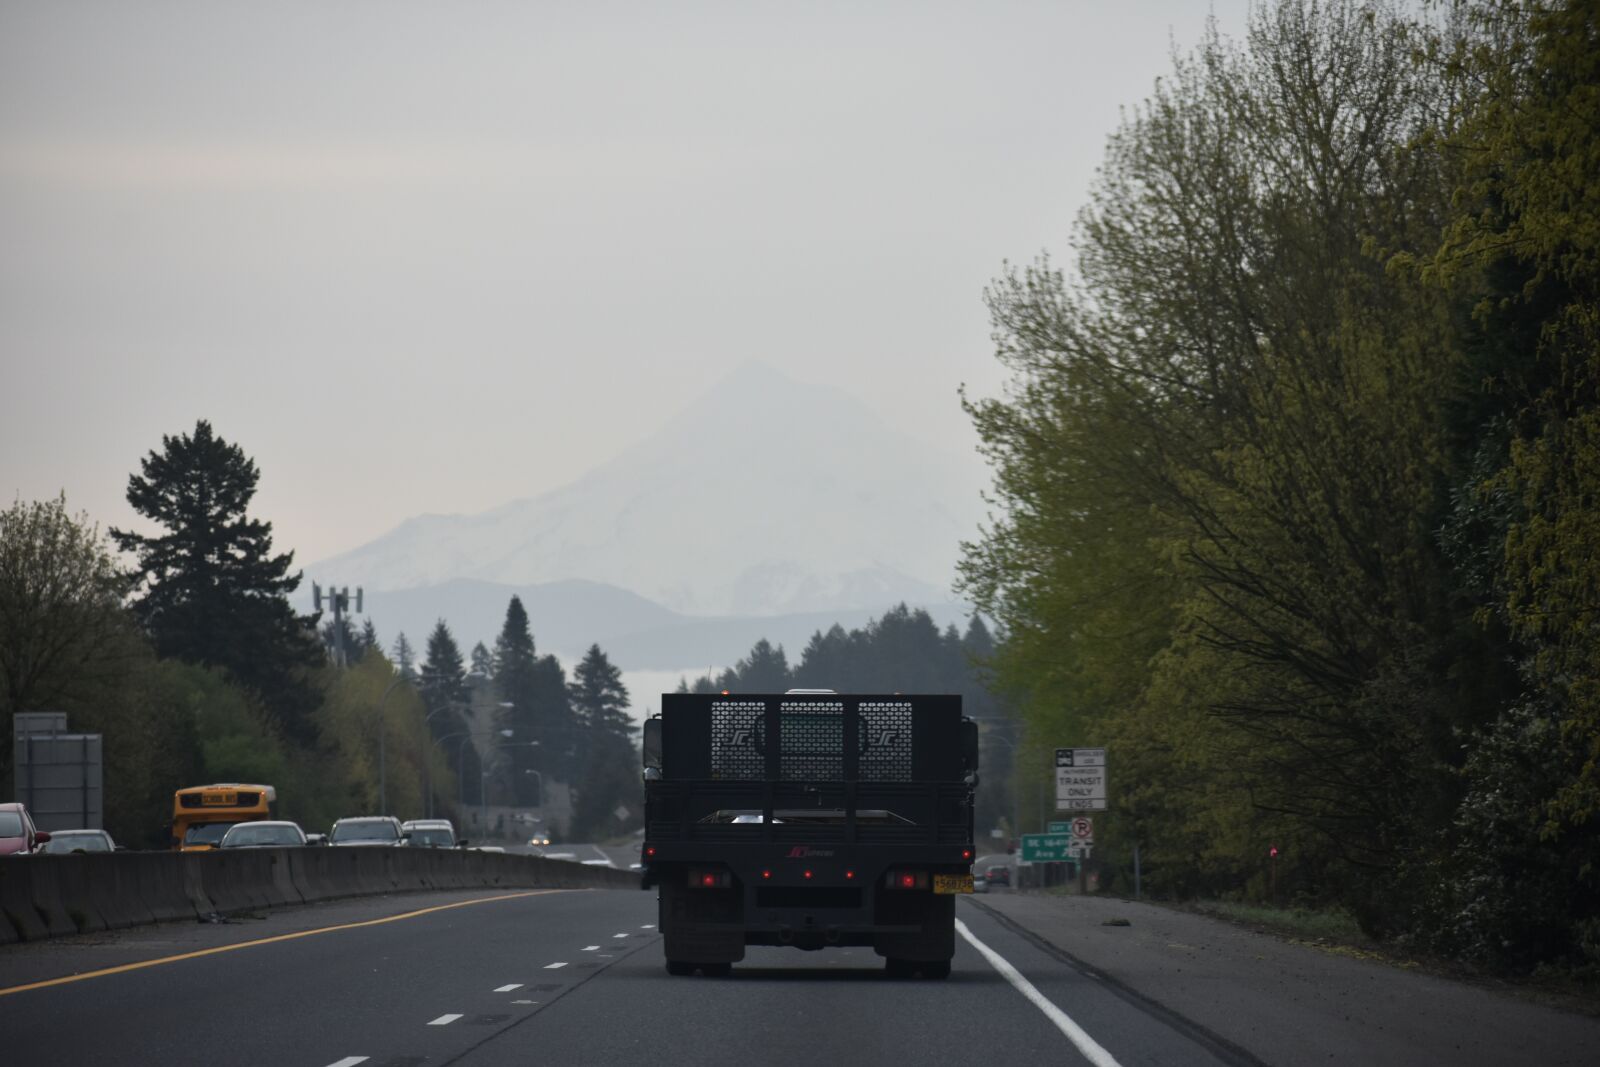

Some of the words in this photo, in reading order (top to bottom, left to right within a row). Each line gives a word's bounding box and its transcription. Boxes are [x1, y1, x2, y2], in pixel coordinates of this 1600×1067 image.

[1059, 777, 1101, 785] TRANSIT
[1069, 788, 1092, 796] ONLY
[225, 795, 236, 803] BUS
[1069, 800, 1092, 808] ENDS
[1035, 850, 1054, 858] Ave
